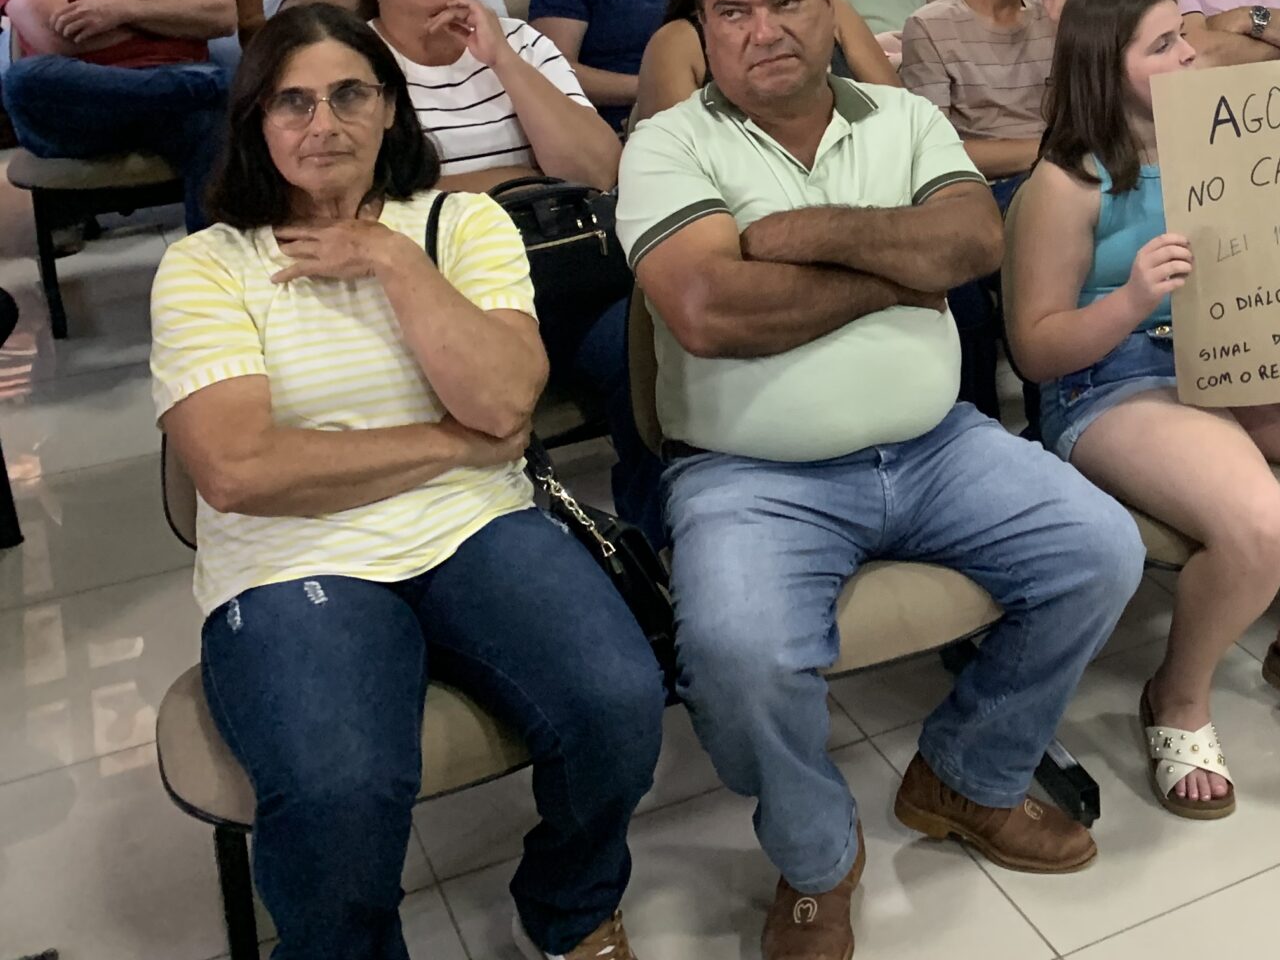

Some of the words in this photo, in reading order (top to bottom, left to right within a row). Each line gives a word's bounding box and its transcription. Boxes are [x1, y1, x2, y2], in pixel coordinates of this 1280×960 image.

[1188, 176, 1225, 213] NO
[1216, 234, 1249, 263] LEI
[1209, 302, 1225, 320] O
[1199, 342, 1251, 362] SINAL
[1196, 372, 1233, 390] COM
[1240, 371, 1252, 383] O
